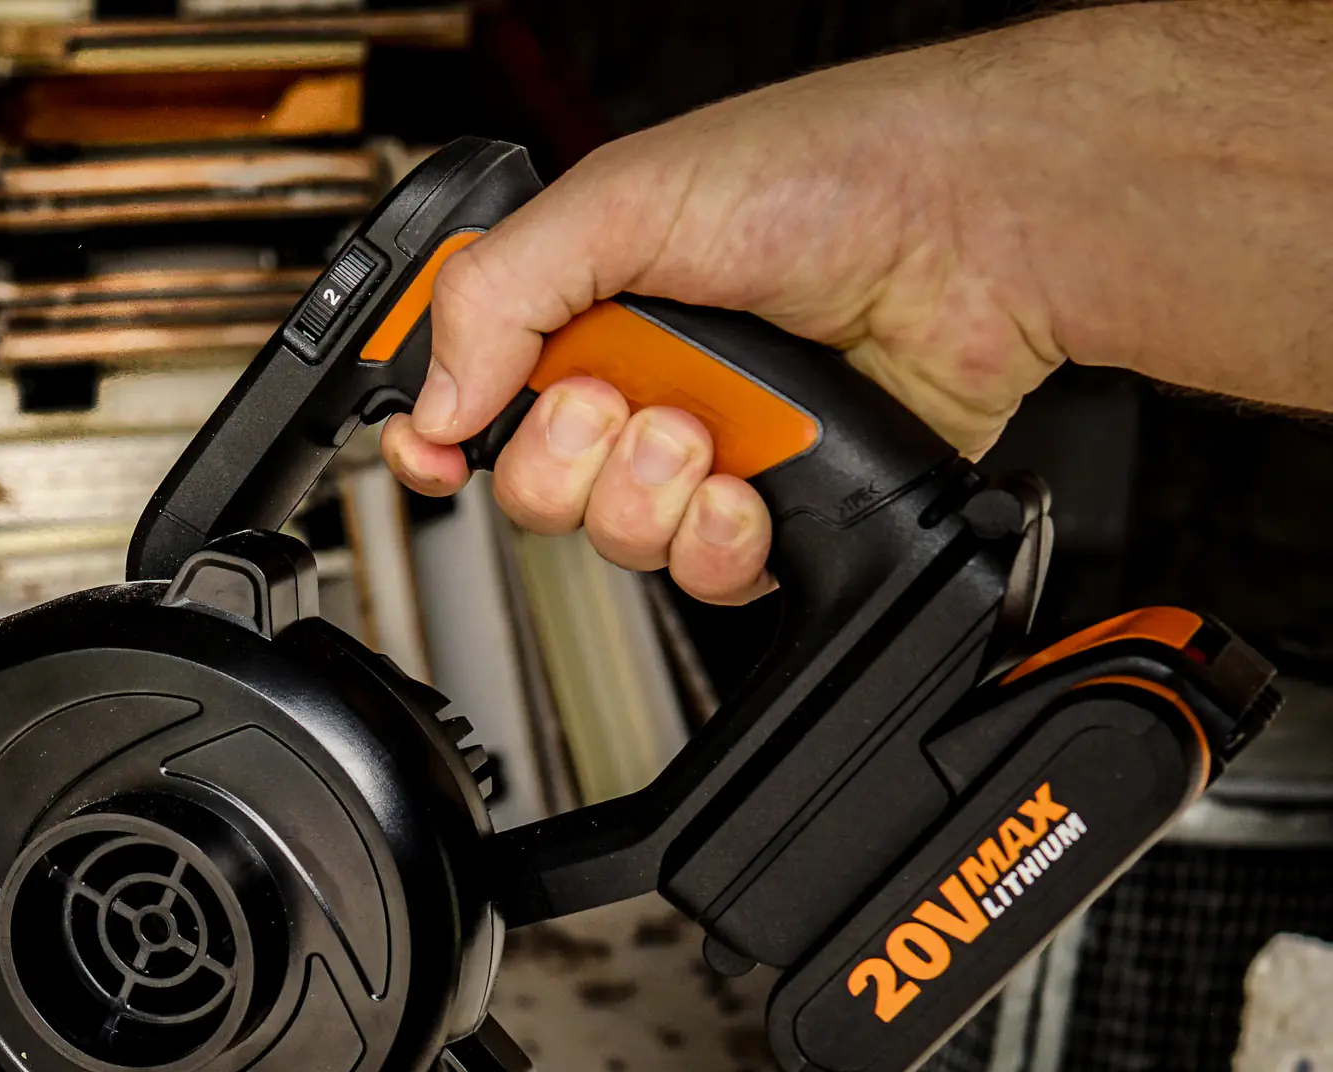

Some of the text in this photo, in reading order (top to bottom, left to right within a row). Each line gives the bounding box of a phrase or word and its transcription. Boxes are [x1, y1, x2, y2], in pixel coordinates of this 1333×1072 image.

[322, 288, 341, 306] 2
[958, 781, 1069, 897] MAX
[981, 811, 1088, 920] LITHIUM
